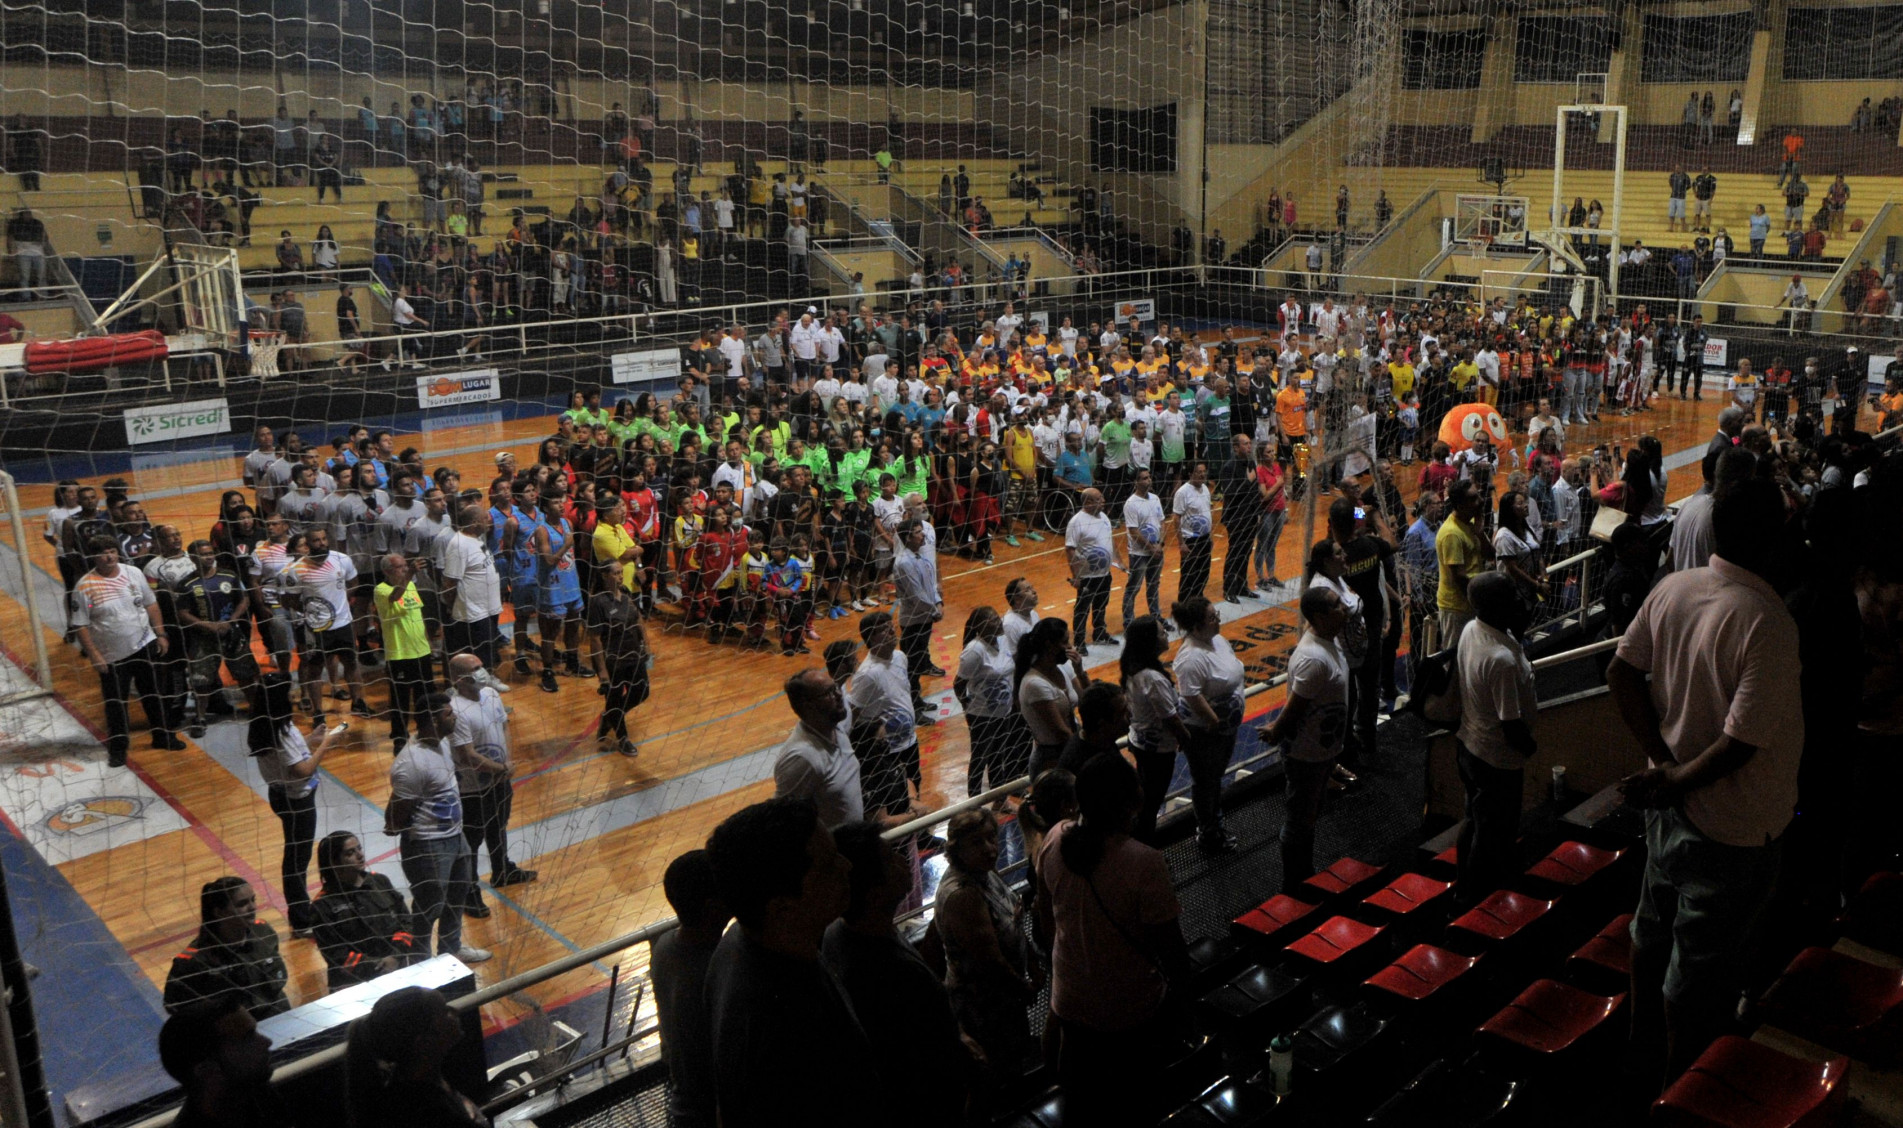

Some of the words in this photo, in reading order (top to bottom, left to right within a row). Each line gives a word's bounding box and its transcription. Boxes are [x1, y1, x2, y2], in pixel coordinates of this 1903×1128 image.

[462, 379, 491, 389] LUGAR
[430, 392, 492, 405] SUPERMERCADOS
[159, 408, 223, 430] Sicredi
